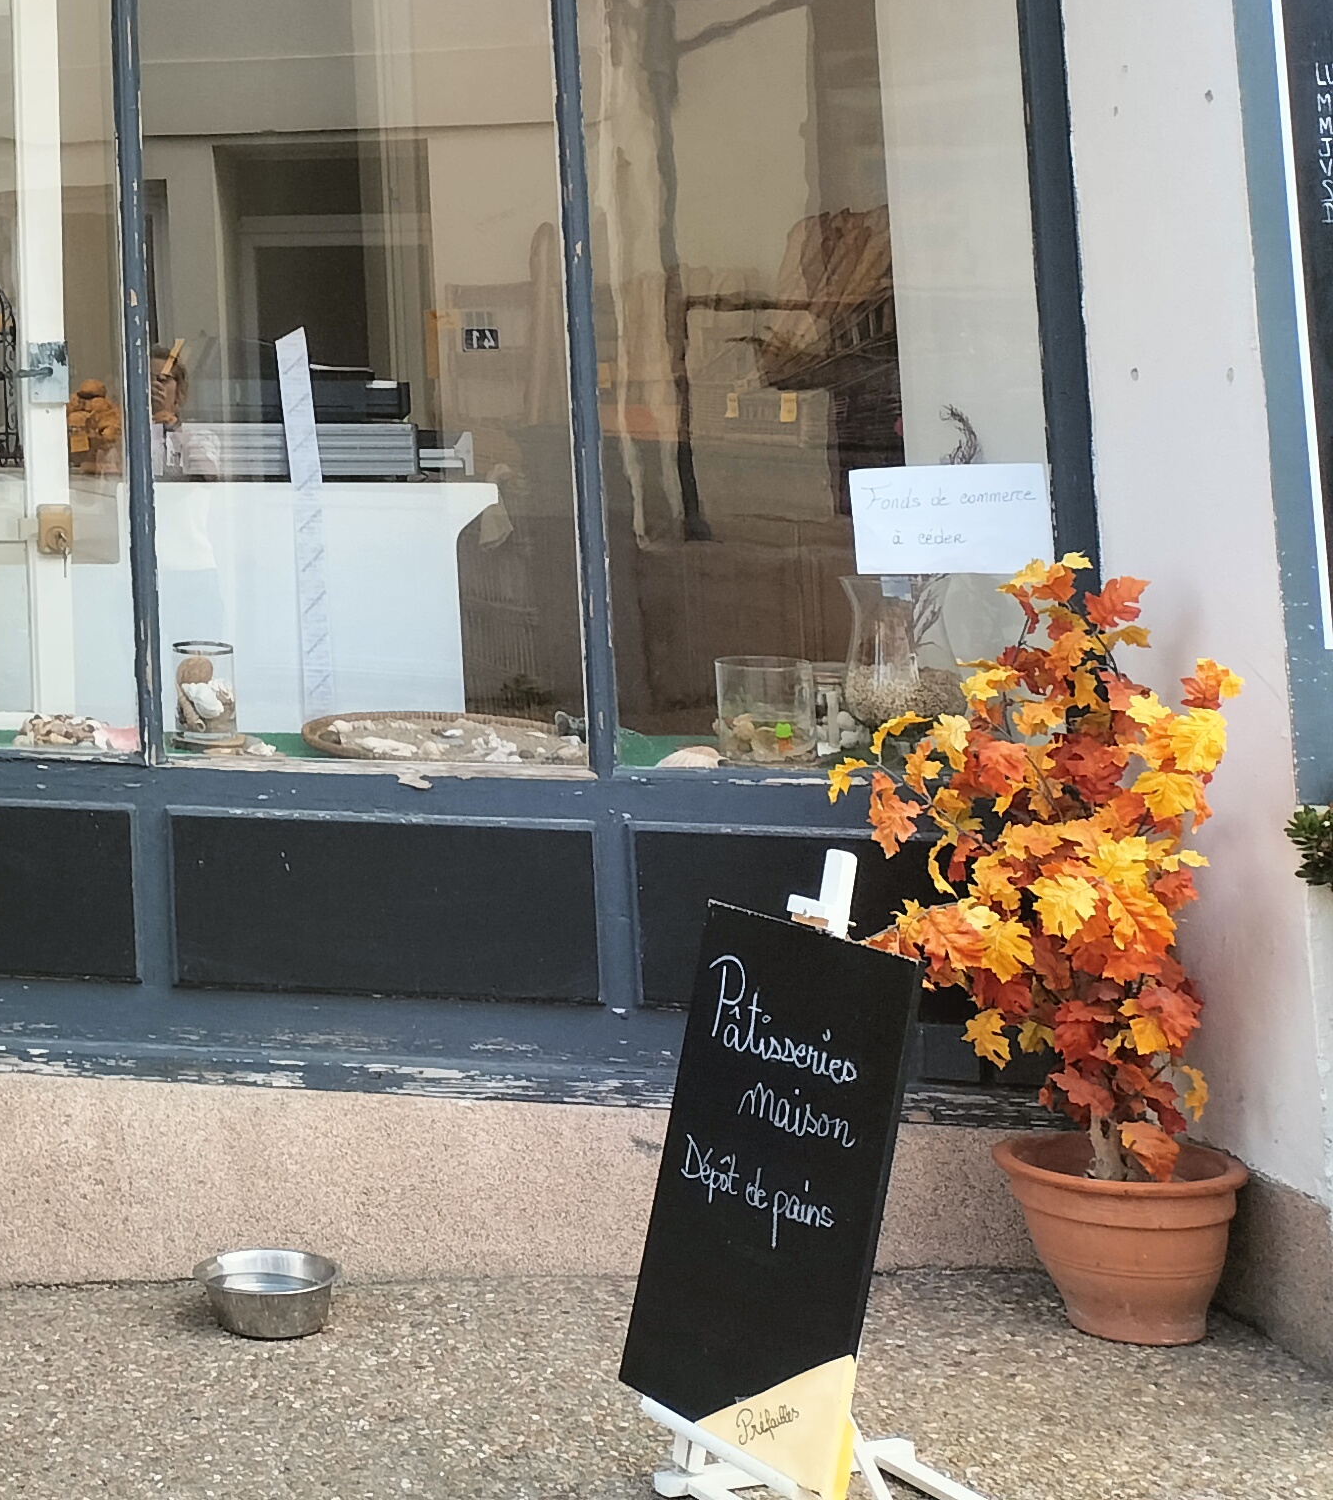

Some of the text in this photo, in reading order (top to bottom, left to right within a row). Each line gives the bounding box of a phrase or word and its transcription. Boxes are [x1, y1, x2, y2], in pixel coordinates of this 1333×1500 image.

[861, 482, 1037, 510] Fonds de commerce
[892, 529, 903, 545] à
[709, 954, 858, 1083] Pâtisseries
[681, 1134, 835, 1249] Dépôt de pains
